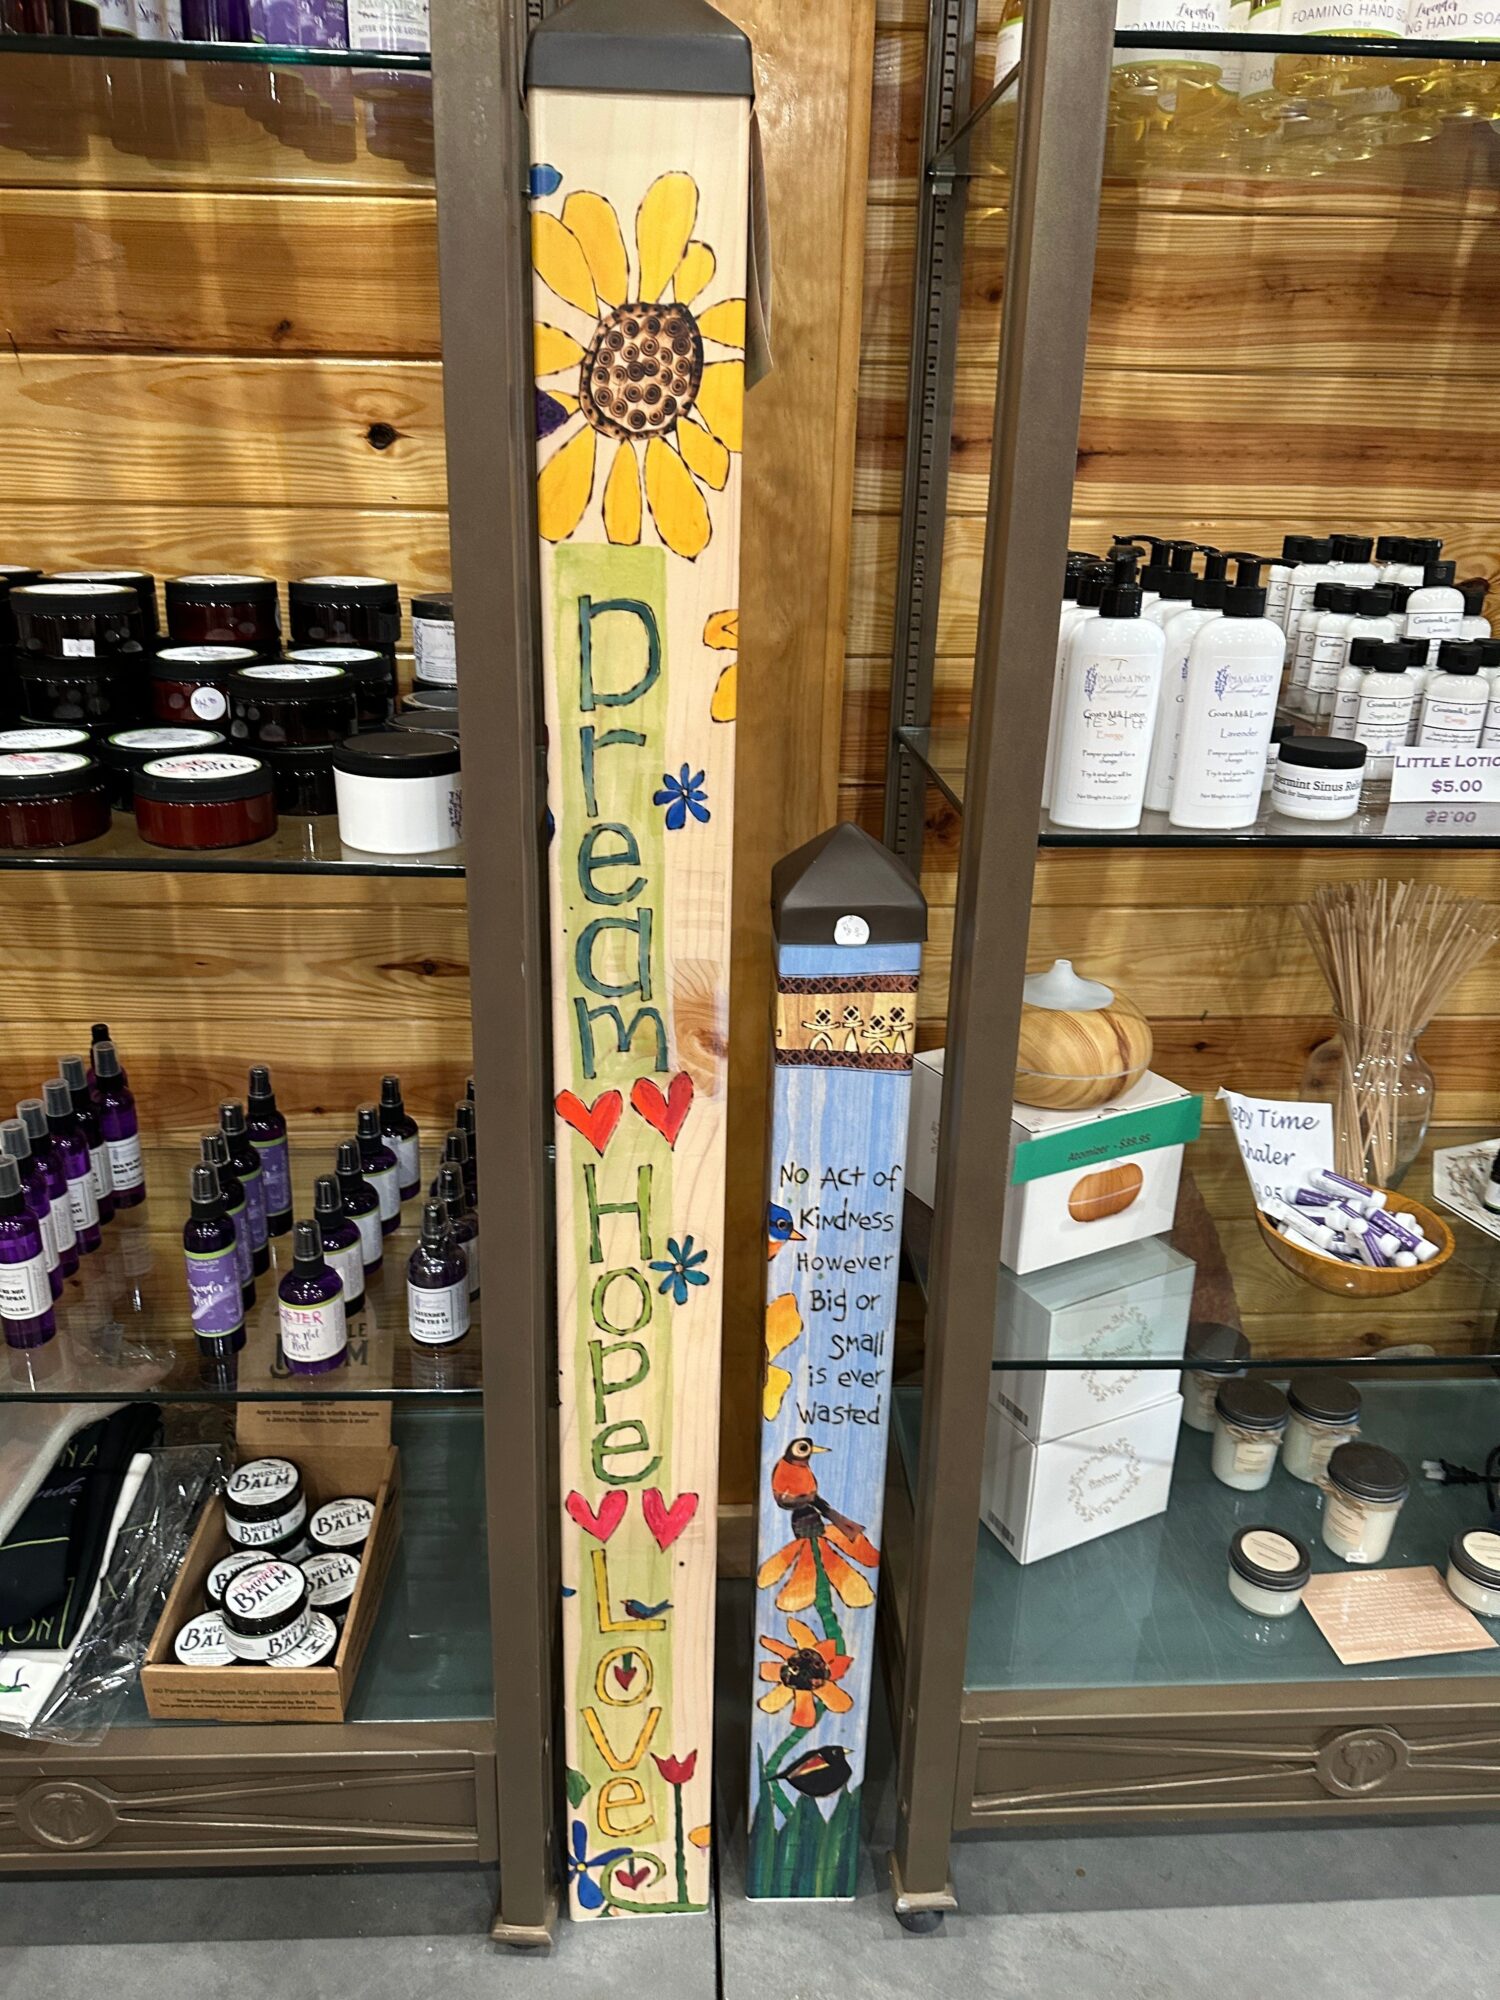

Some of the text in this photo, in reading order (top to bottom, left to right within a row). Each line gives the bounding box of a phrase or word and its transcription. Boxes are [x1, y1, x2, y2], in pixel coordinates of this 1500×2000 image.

[1291, 3, 1354, 25] FOAMING
[1358, 3, 1395, 18] HAND
[1426, 14, 1469, 30] HAND
[1473, 12, 1500, 25] SOA
[1220, 727, 1259, 739] Lavender
[1395, 755, 1500, 768] LITTLE LOTIO
[1313, 780, 1343, 792] Sinus
[1431, 778, 1483, 795] $5.00
[1232, 1105, 1321, 1131] epy Time
[1241, 1138, 1296, 1166] haler
[780, 1163, 809, 1188] No
[873, 1165, 902, 1192] of
[797, 1252, 895, 1274] However
[810, 1288, 881, 1322] Big or
[280, 1308, 324, 1325] ESTER
[582, 1163, 664, 1486] Hope
[808, 1365, 885, 1388] is ever
[231, 1474, 290, 1492] BALM
[252, 1468, 290, 1479] MUSCLE
[316, 1510, 371, 1536] BALM
[331, 1504, 368, 1521] MUSCLE
[240, 1523, 283, 1544] BALM
[311, 1558, 348, 1579] MUSCLE
[232, 1569, 292, 1613] BALM
[180, 1628, 225, 1651] BAL
[580, 1548, 667, 1838] Love
